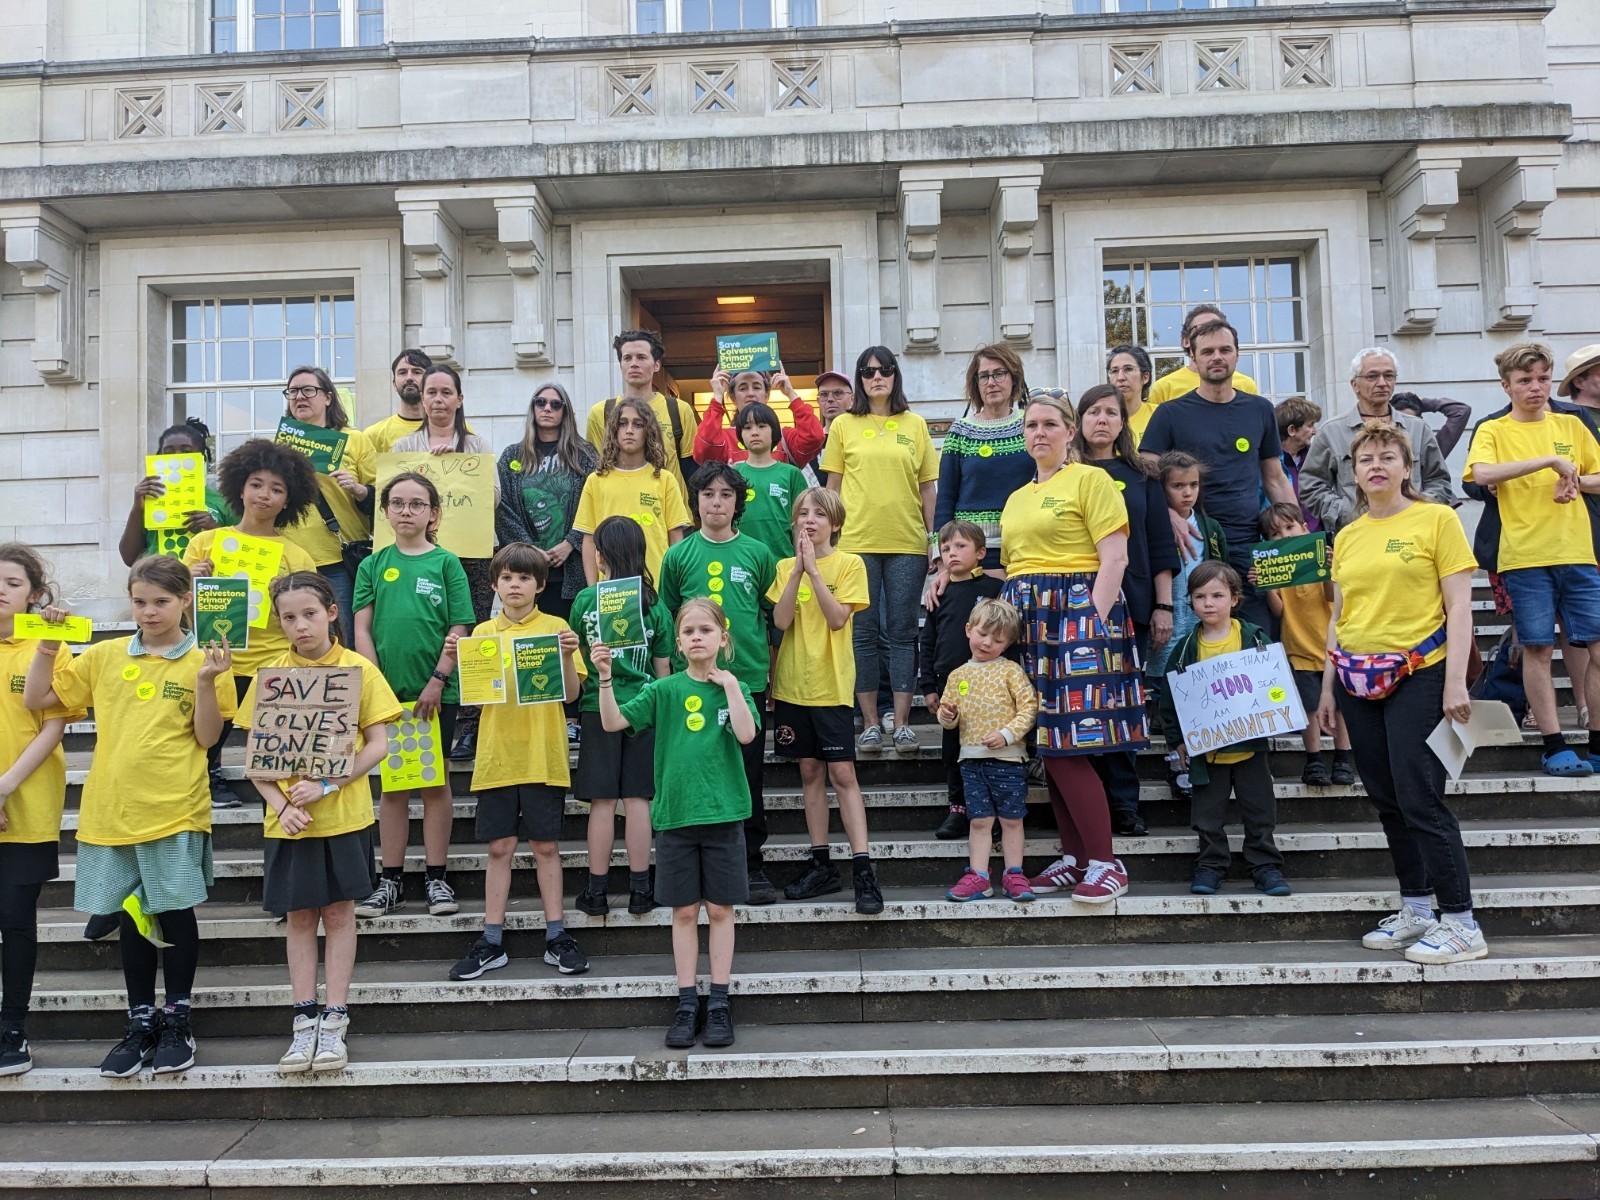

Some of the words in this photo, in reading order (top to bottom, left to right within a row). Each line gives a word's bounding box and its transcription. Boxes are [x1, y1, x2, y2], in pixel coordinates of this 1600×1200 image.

[719, 341, 741, 349] Save
[720, 346, 768, 356] Colvestone
[720, 354, 754, 363] Primary
[721, 360, 750, 369] School
[280, 423, 305, 437] Save
[278, 432, 333, 453] Colvestone
[1252, 548, 1279, 559] Save
[1254, 551, 1314, 567] Colvestone
[1255, 563, 1297, 575] Primary
[1257, 571, 1292, 585] School
[600, 586, 617, 594] Save
[600, 589, 638, 600] Colvestone
[197, 597, 232, 605] Primary
[600, 597, 626, 606] Primary
[600, 604, 623, 613] School
[516, 647, 558, 655] Colvestone
[517, 654, 546, 662] Primary
[517, 660, 542, 668] School
[1174, 681, 1189, 702] I
[1191, 667, 1209, 686] AM
[1212, 660, 1238, 677] MORE
[1240, 652, 1271, 667] THAN
[1273, 660, 1280, 671] A
[263, 672, 351, 703] SAVE
[1257, 677, 1277, 689] SEAT
[1189, 717, 1202, 730] I
[1213, 707, 1231, 720] AM
[1251, 698, 1260, 709] A
[1186, 705, 1294, 751] COMMUNITY
[252, 732, 329, 753] TONE
[251, 754, 347, 775] PRIMARY!
